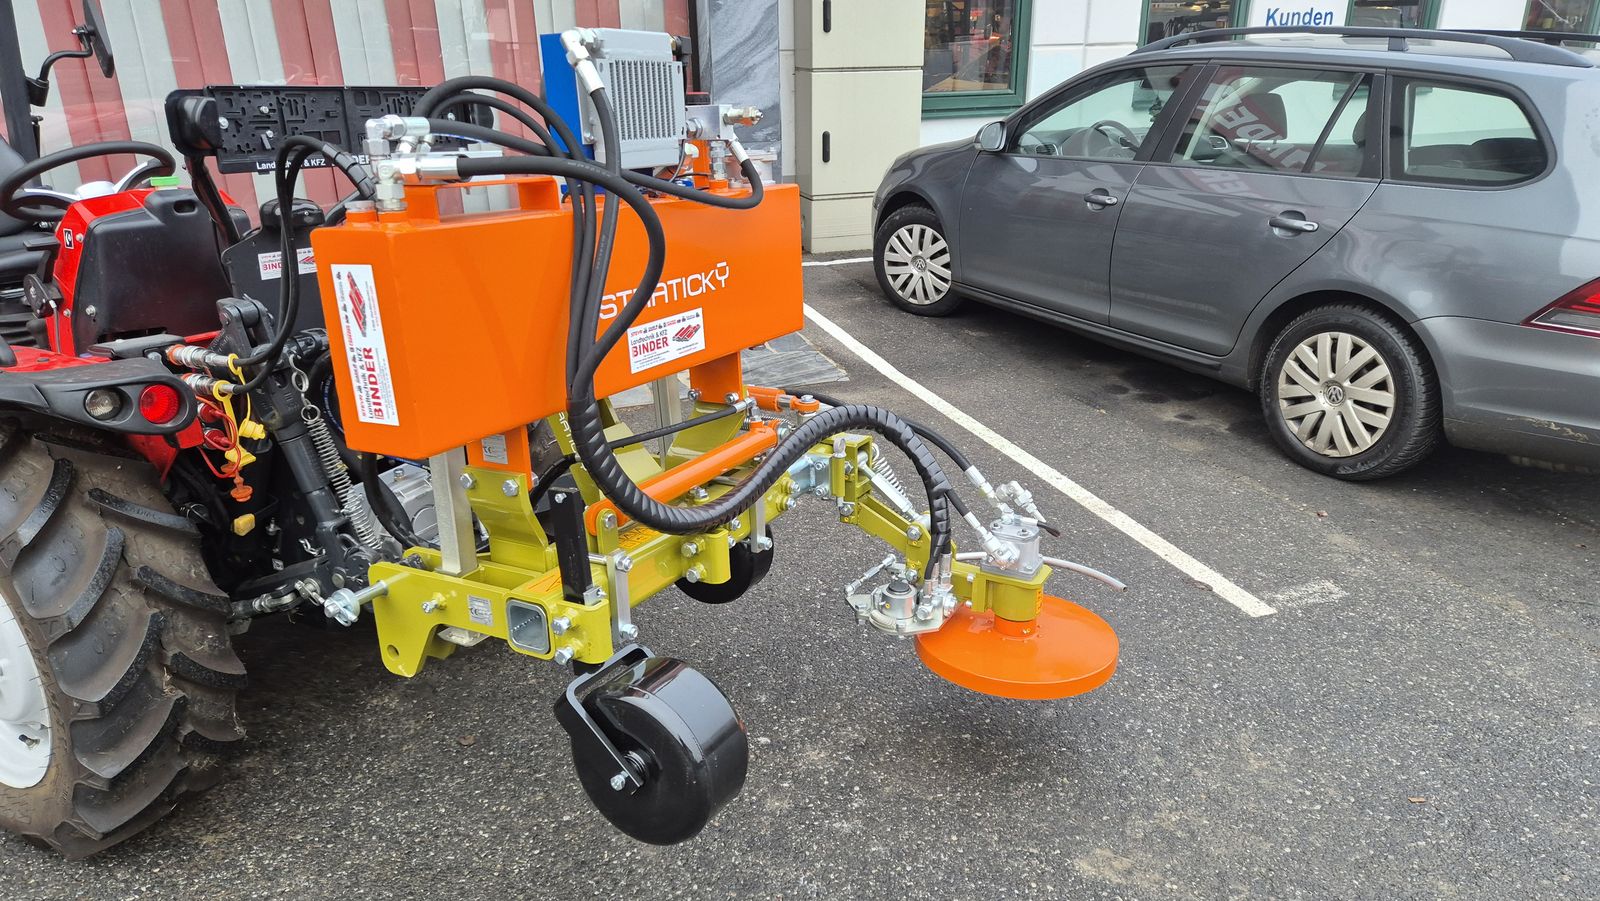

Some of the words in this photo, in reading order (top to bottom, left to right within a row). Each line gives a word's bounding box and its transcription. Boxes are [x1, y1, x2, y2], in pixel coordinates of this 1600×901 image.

[1265, 7, 1334, 27] Kunden
[311, 158, 326, 167] KFZ
[631, 336, 669, 358] BINDER
[362, 346, 385, 420] BINDER
